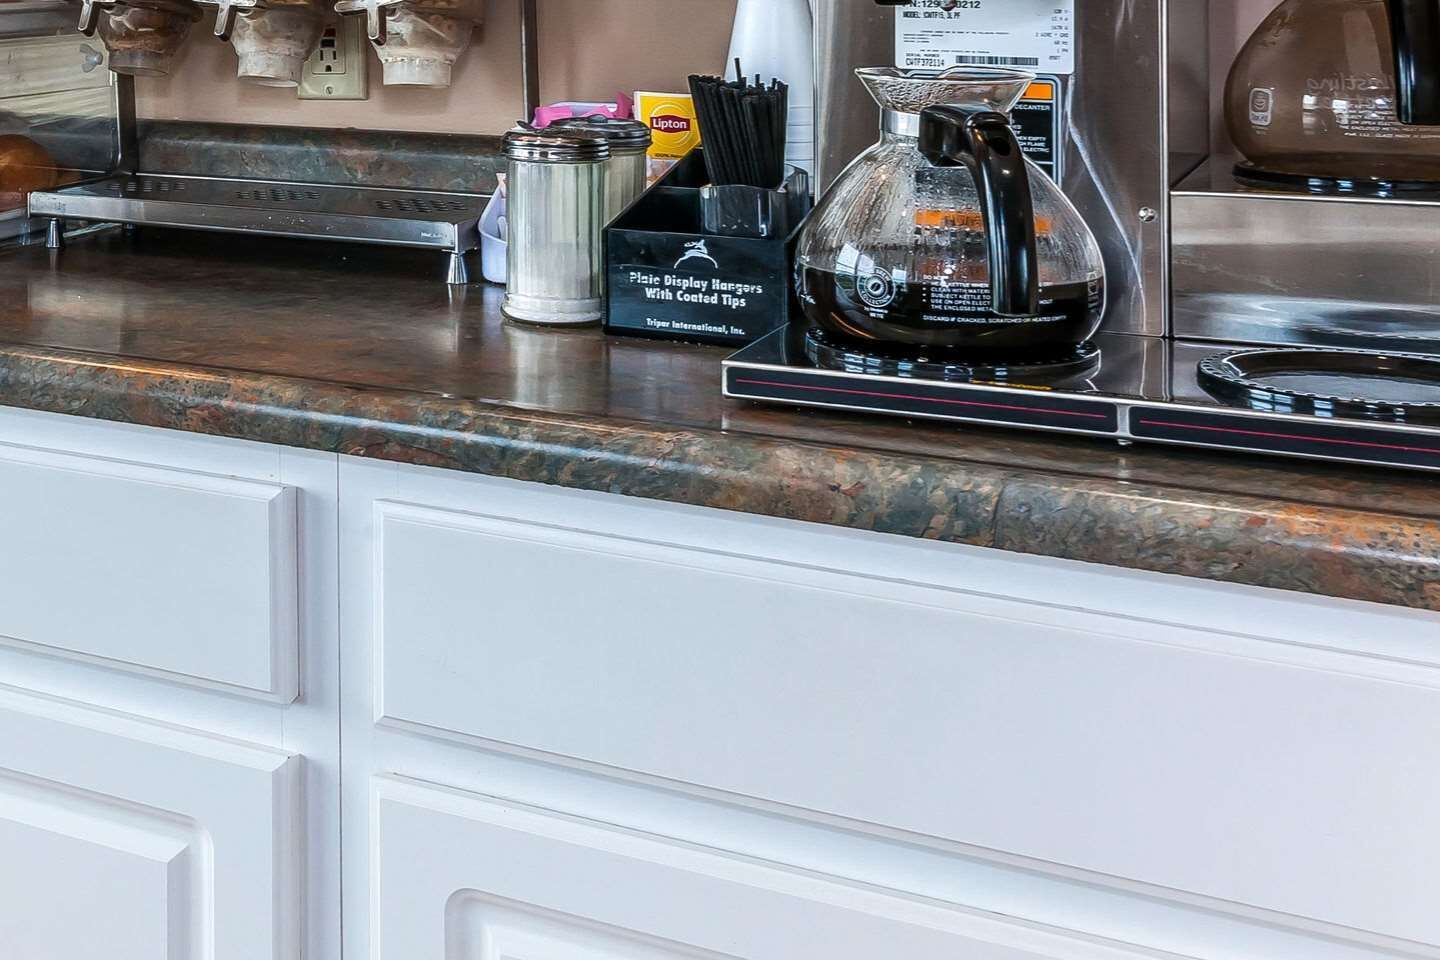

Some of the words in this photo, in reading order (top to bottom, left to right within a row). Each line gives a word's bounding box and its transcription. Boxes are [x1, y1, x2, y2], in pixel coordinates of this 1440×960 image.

[652, 118, 687, 130] Lipton
[664, 275, 708, 292] Display
[711, 278, 763, 296] Hangers
[645, 287, 673, 300] With
[676, 290, 718, 304] Coated
[721, 293, 746, 309] Tips
[646, 318, 670, 329] Tripar
[672, 321, 728, 334] International,
[730, 326, 745, 335] Inc.
